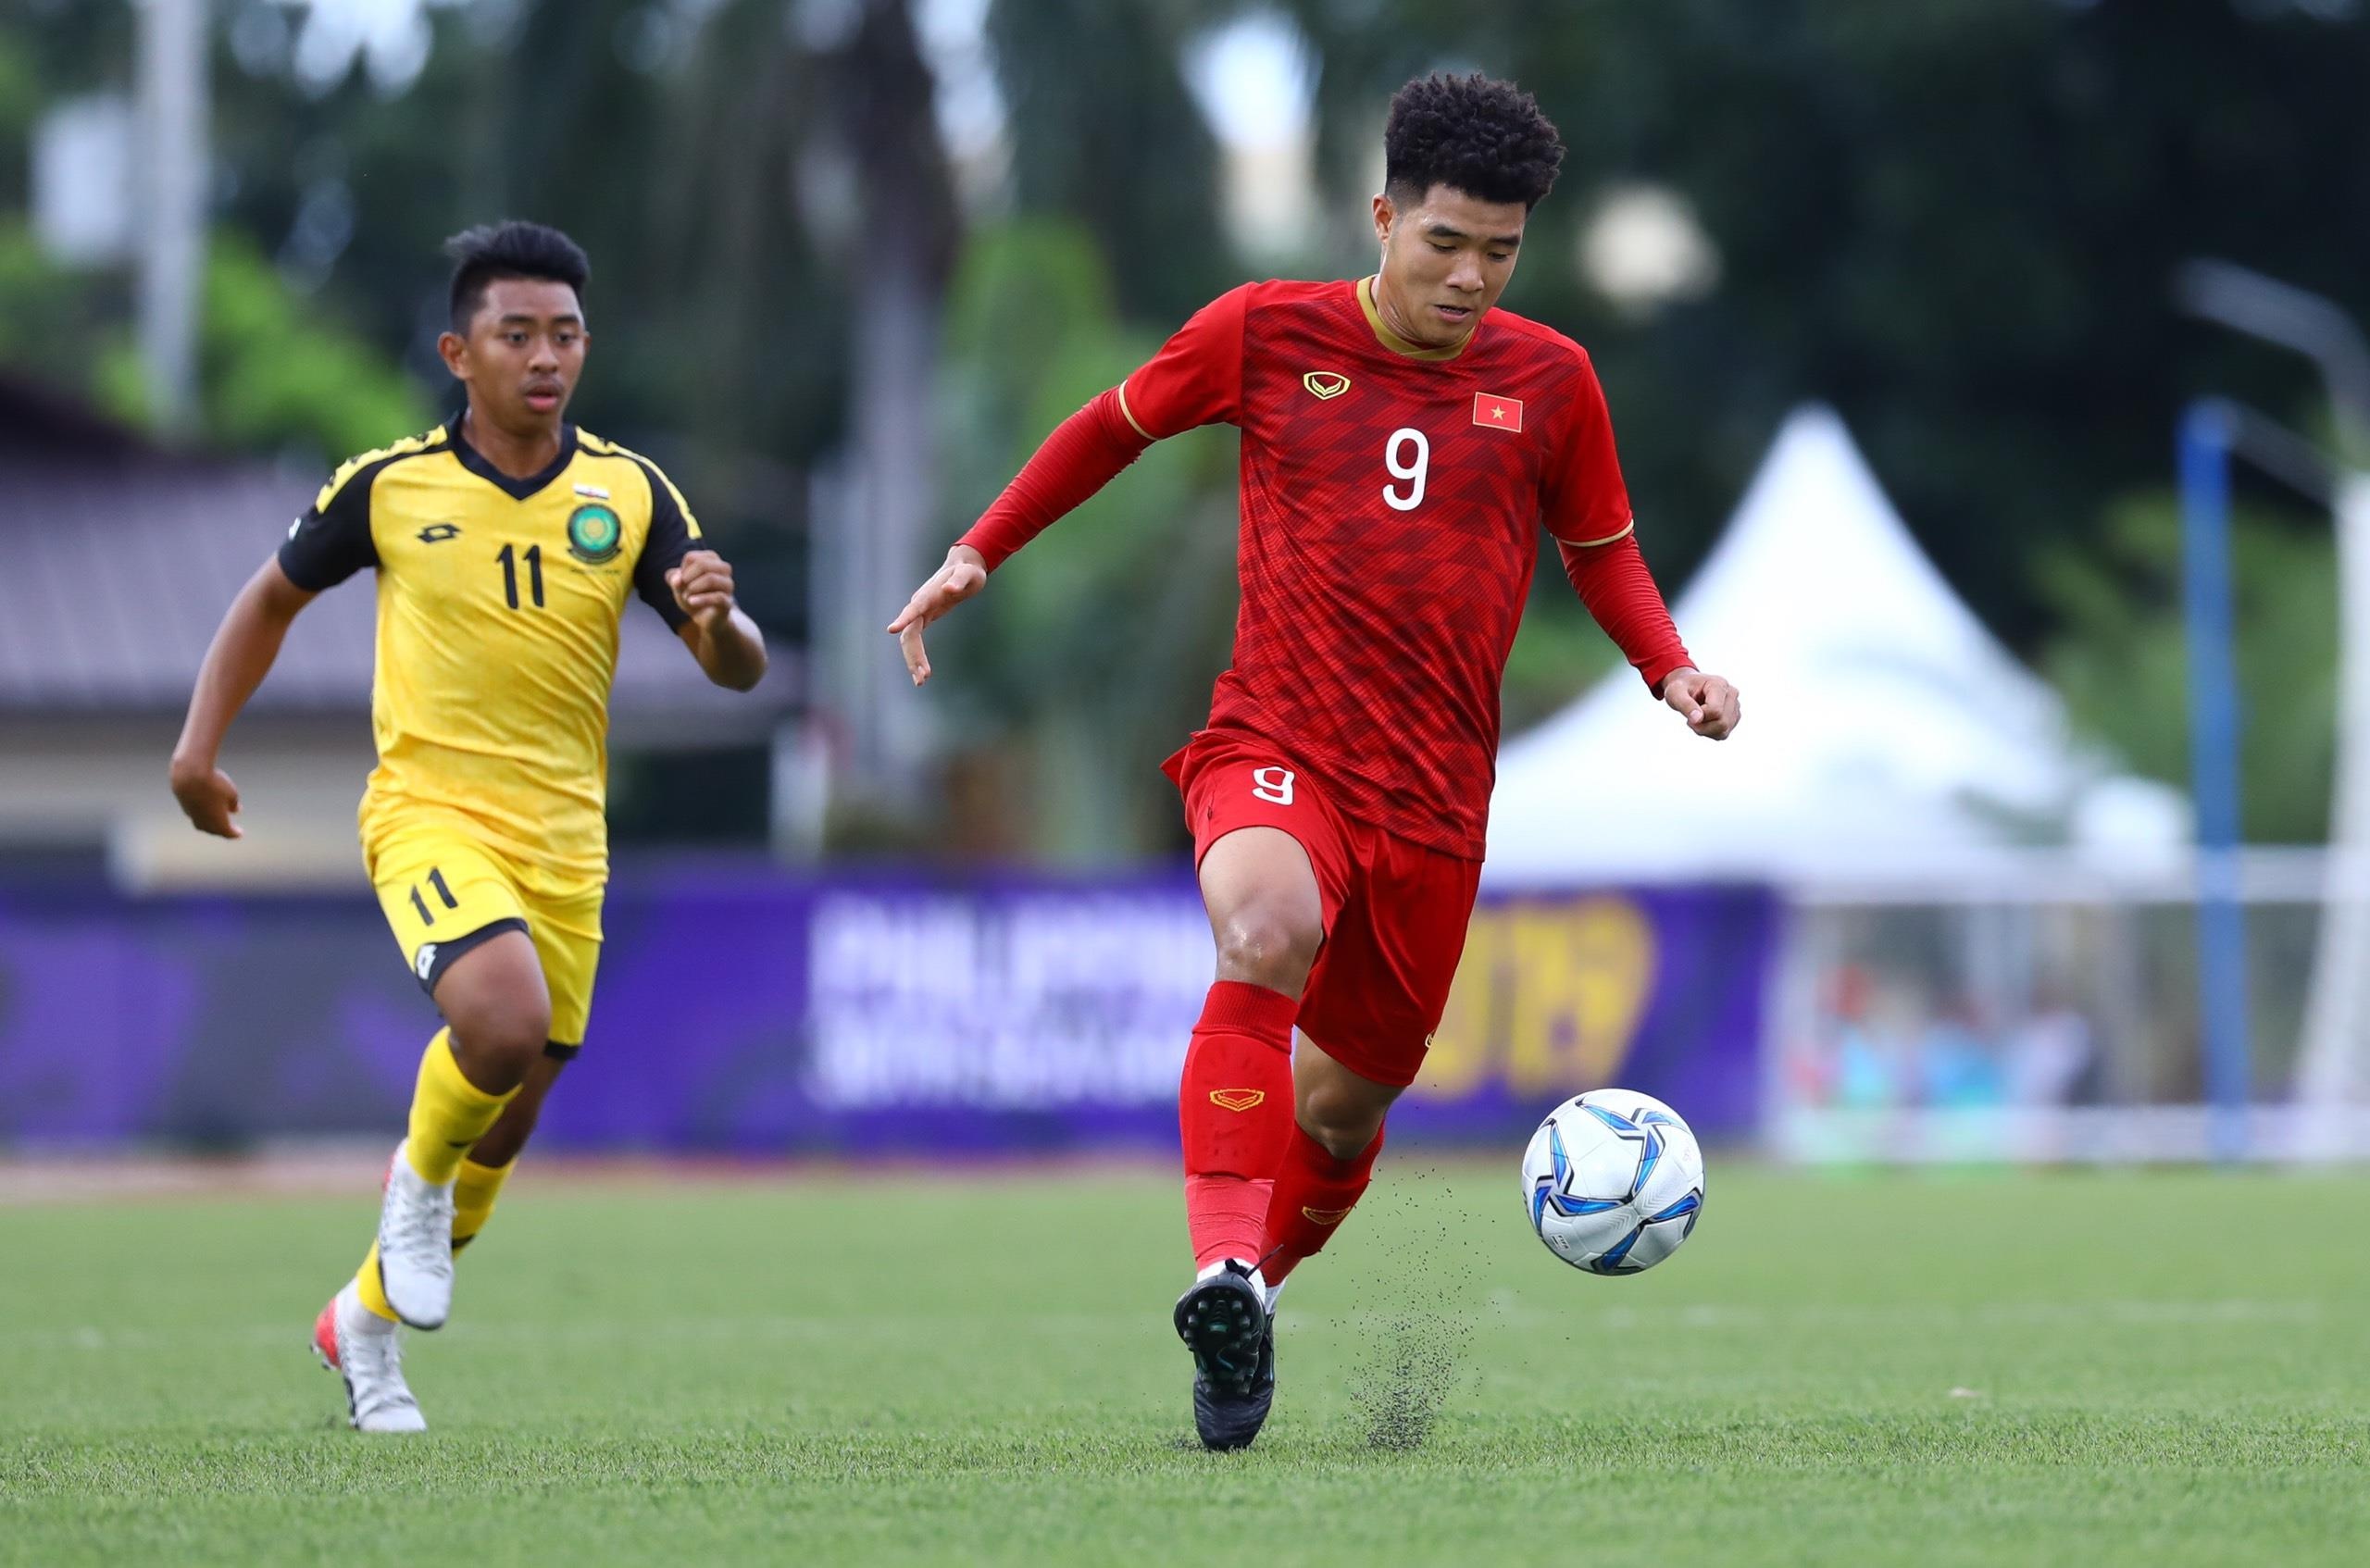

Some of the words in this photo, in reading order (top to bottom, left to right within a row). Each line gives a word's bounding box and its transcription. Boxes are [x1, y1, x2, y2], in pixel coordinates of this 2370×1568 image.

[1382, 428, 1429, 511] 9
[495, 542, 544, 610] 11
[1252, 765, 1295, 806] 9
[409, 865, 458, 926] 11
